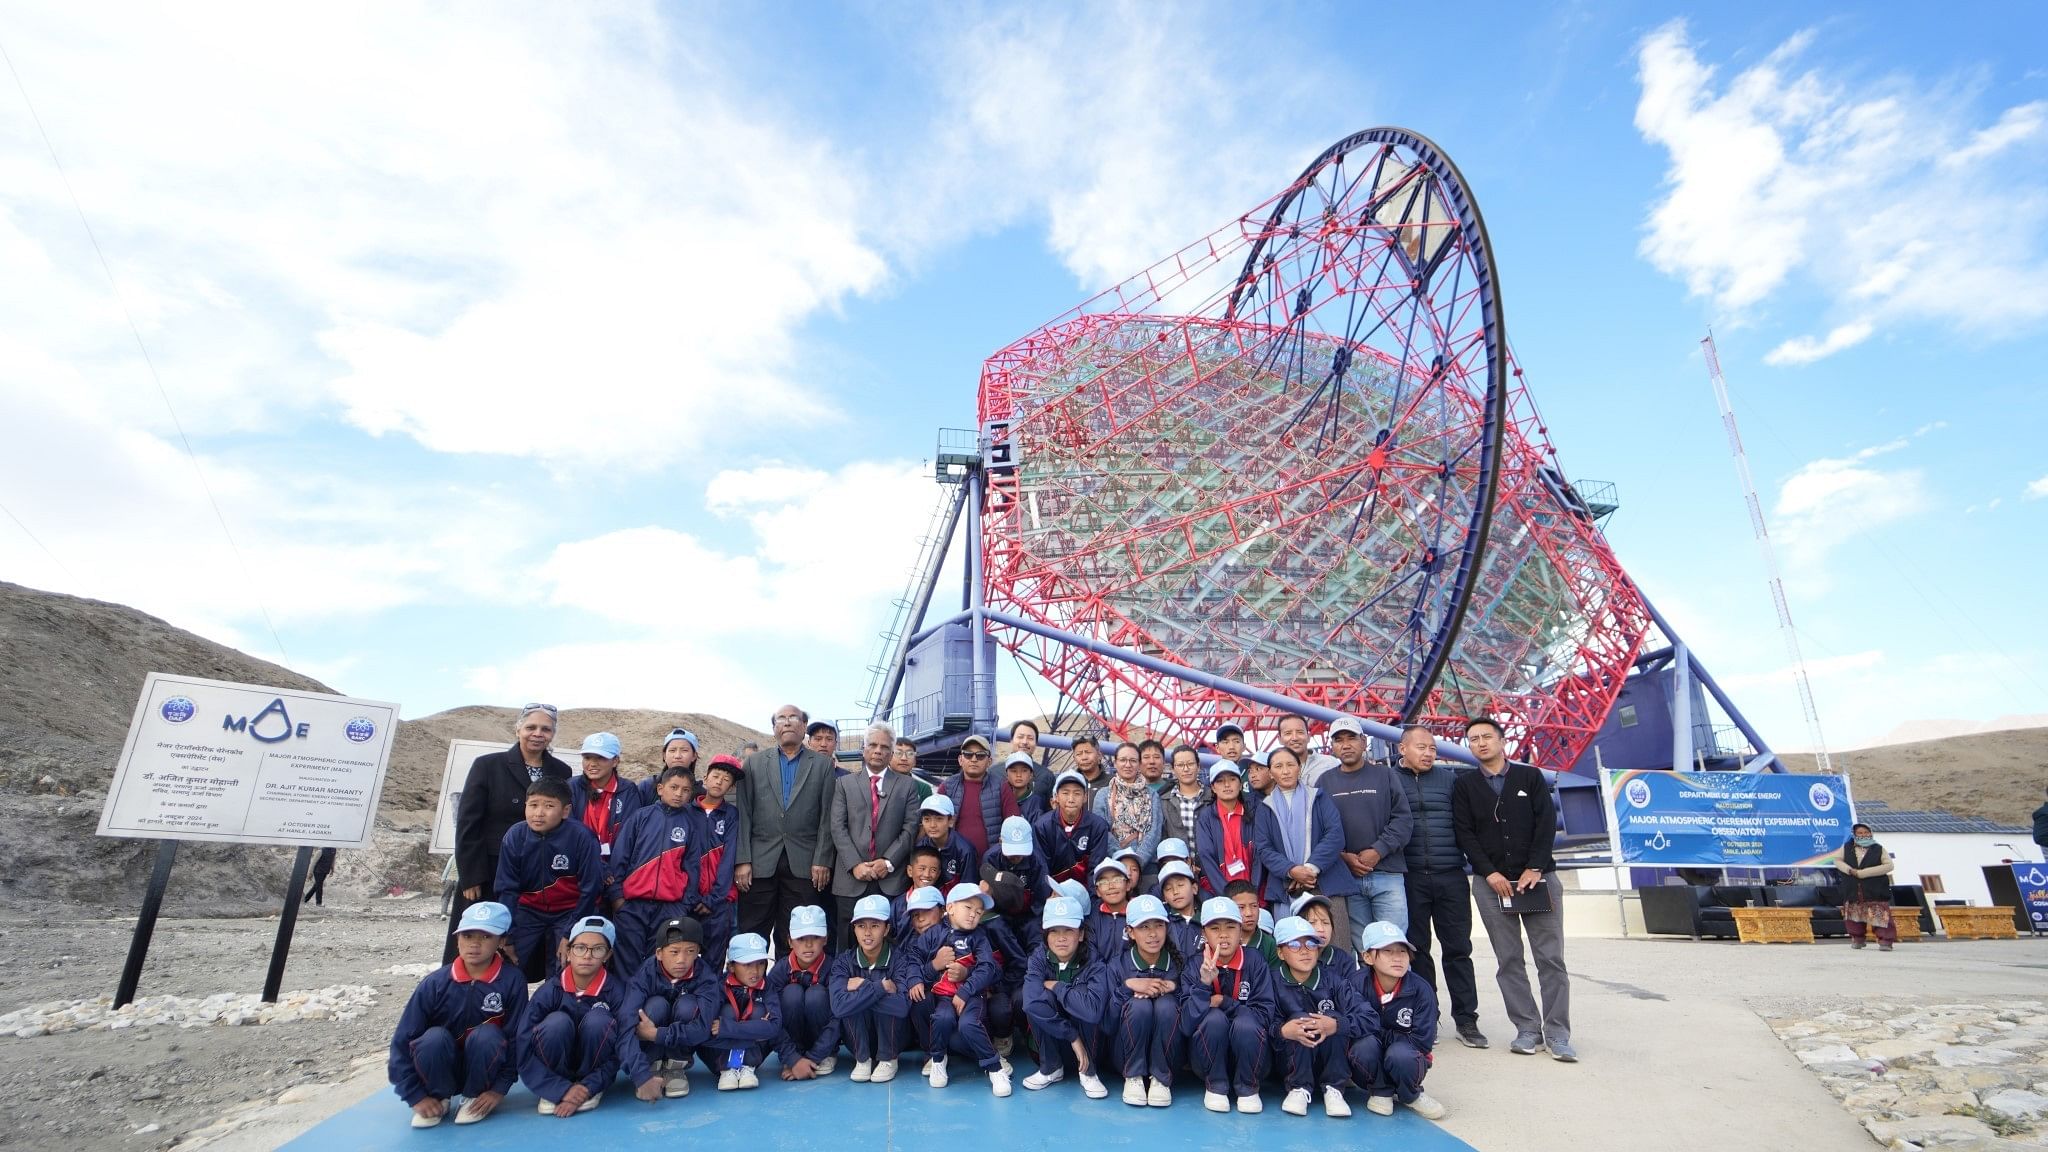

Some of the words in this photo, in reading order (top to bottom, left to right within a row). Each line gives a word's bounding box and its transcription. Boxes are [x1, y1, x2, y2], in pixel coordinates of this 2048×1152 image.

[292, 755, 337, 764] ATMOSPHERIC
[337, 759, 375, 767] CHERENKOV
[290, 763, 331, 771] EXPERIMENT
[158, 773, 184, 782] अजित
[186, 776, 209, 785] कुमार
[326, 787, 364, 796] MOHANTY
[1731, 792, 1758, 800] ATOMIC
[1629, 815, 1658, 824] MAJOR
[1659, 816, 1717, 825] ATMOSPHERIC
[1716, 817, 1762, 826] CHERENKOV
[1764, 818, 1811, 826] EXPERIMENT
[1812, 818, 1839, 827] (MACE)
[1711, 827, 1766, 836] OBSERVATORY
